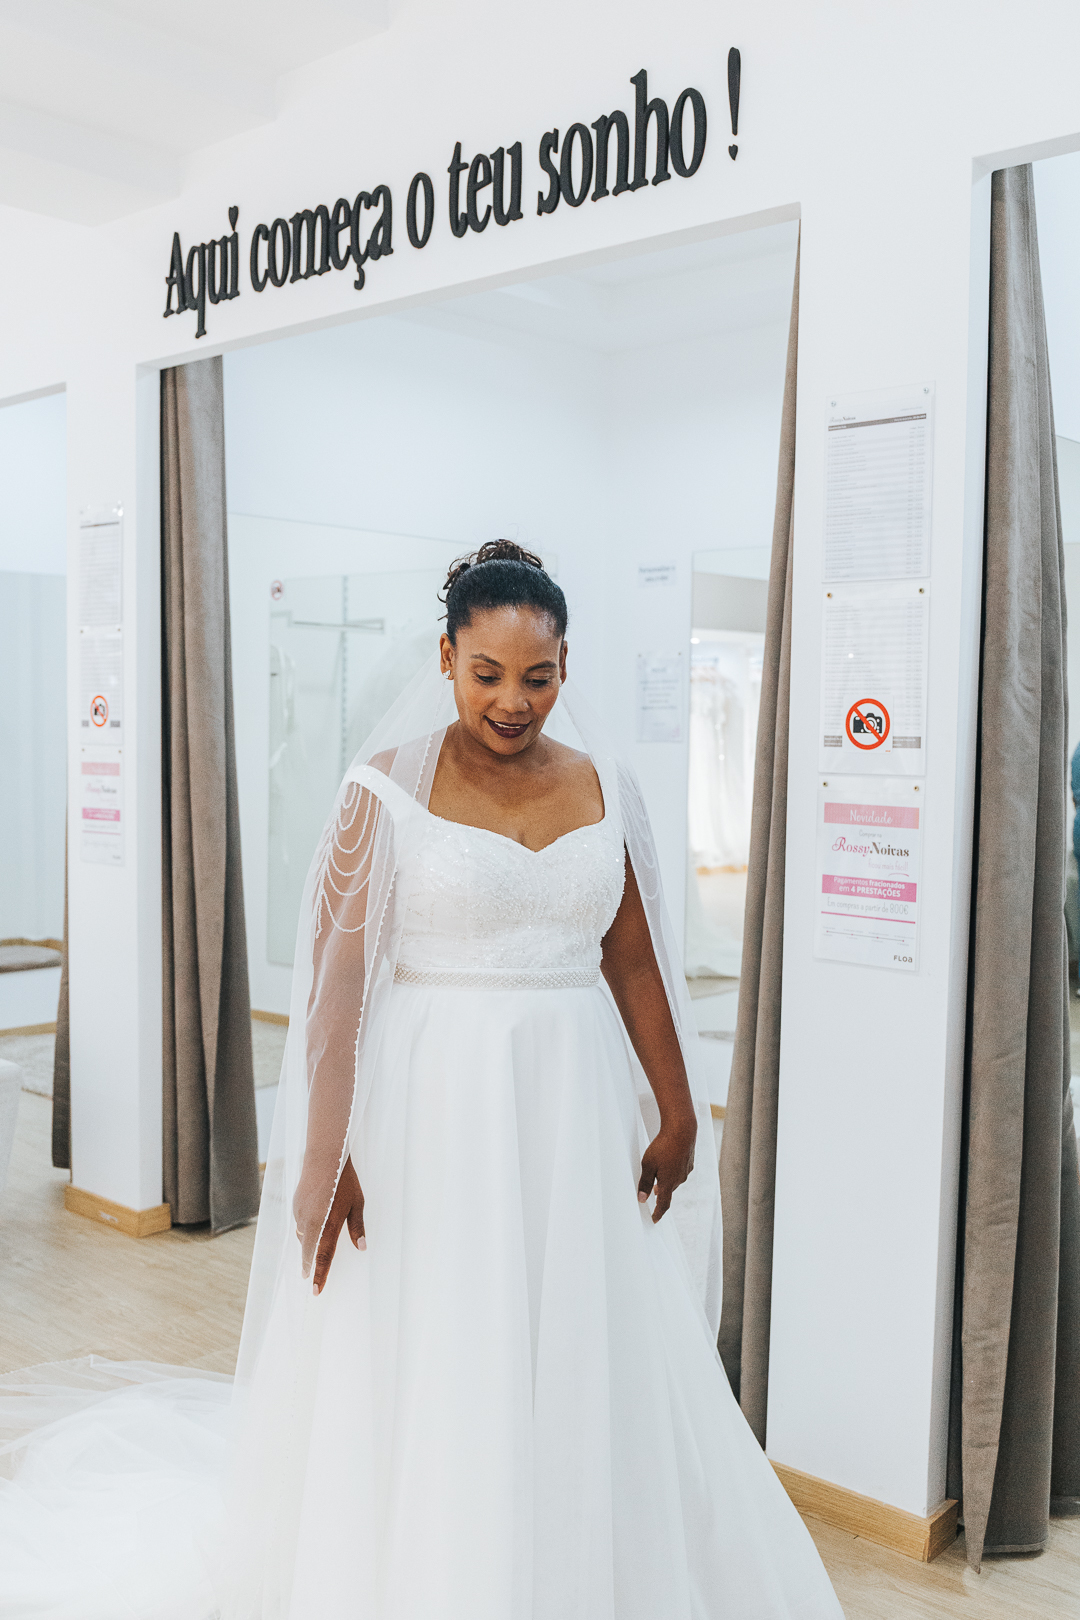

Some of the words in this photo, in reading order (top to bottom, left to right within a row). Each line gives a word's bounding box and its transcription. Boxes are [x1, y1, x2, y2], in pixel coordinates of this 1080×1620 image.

[164, 206, 240, 338] Aqui
[250, 185, 393, 292] começa
[407, 173, 434, 249] o
[448, 142, 523, 238] teu
[537, 69, 707, 216] sonho
[728, 47, 741, 160] !
[850, 809, 893, 824] Novidade
[858, 829, 876, 839] Comprar
[868, 858, 881, 870] ficou
[882, 862, 894, 871] mais
[894, 860, 909, 872] fácil!
[833, 876, 868, 886] Pagamentos
[869, 879, 905, 890] fracionados
[857, 886, 901, 898] PRESTAÇÕES
[827, 896, 836, 907] Em
[837, 900, 860, 911] compras
[865, 903, 881, 913] partir
[881, 902, 888, 913] de
[889, 902, 909, 915] 800€
